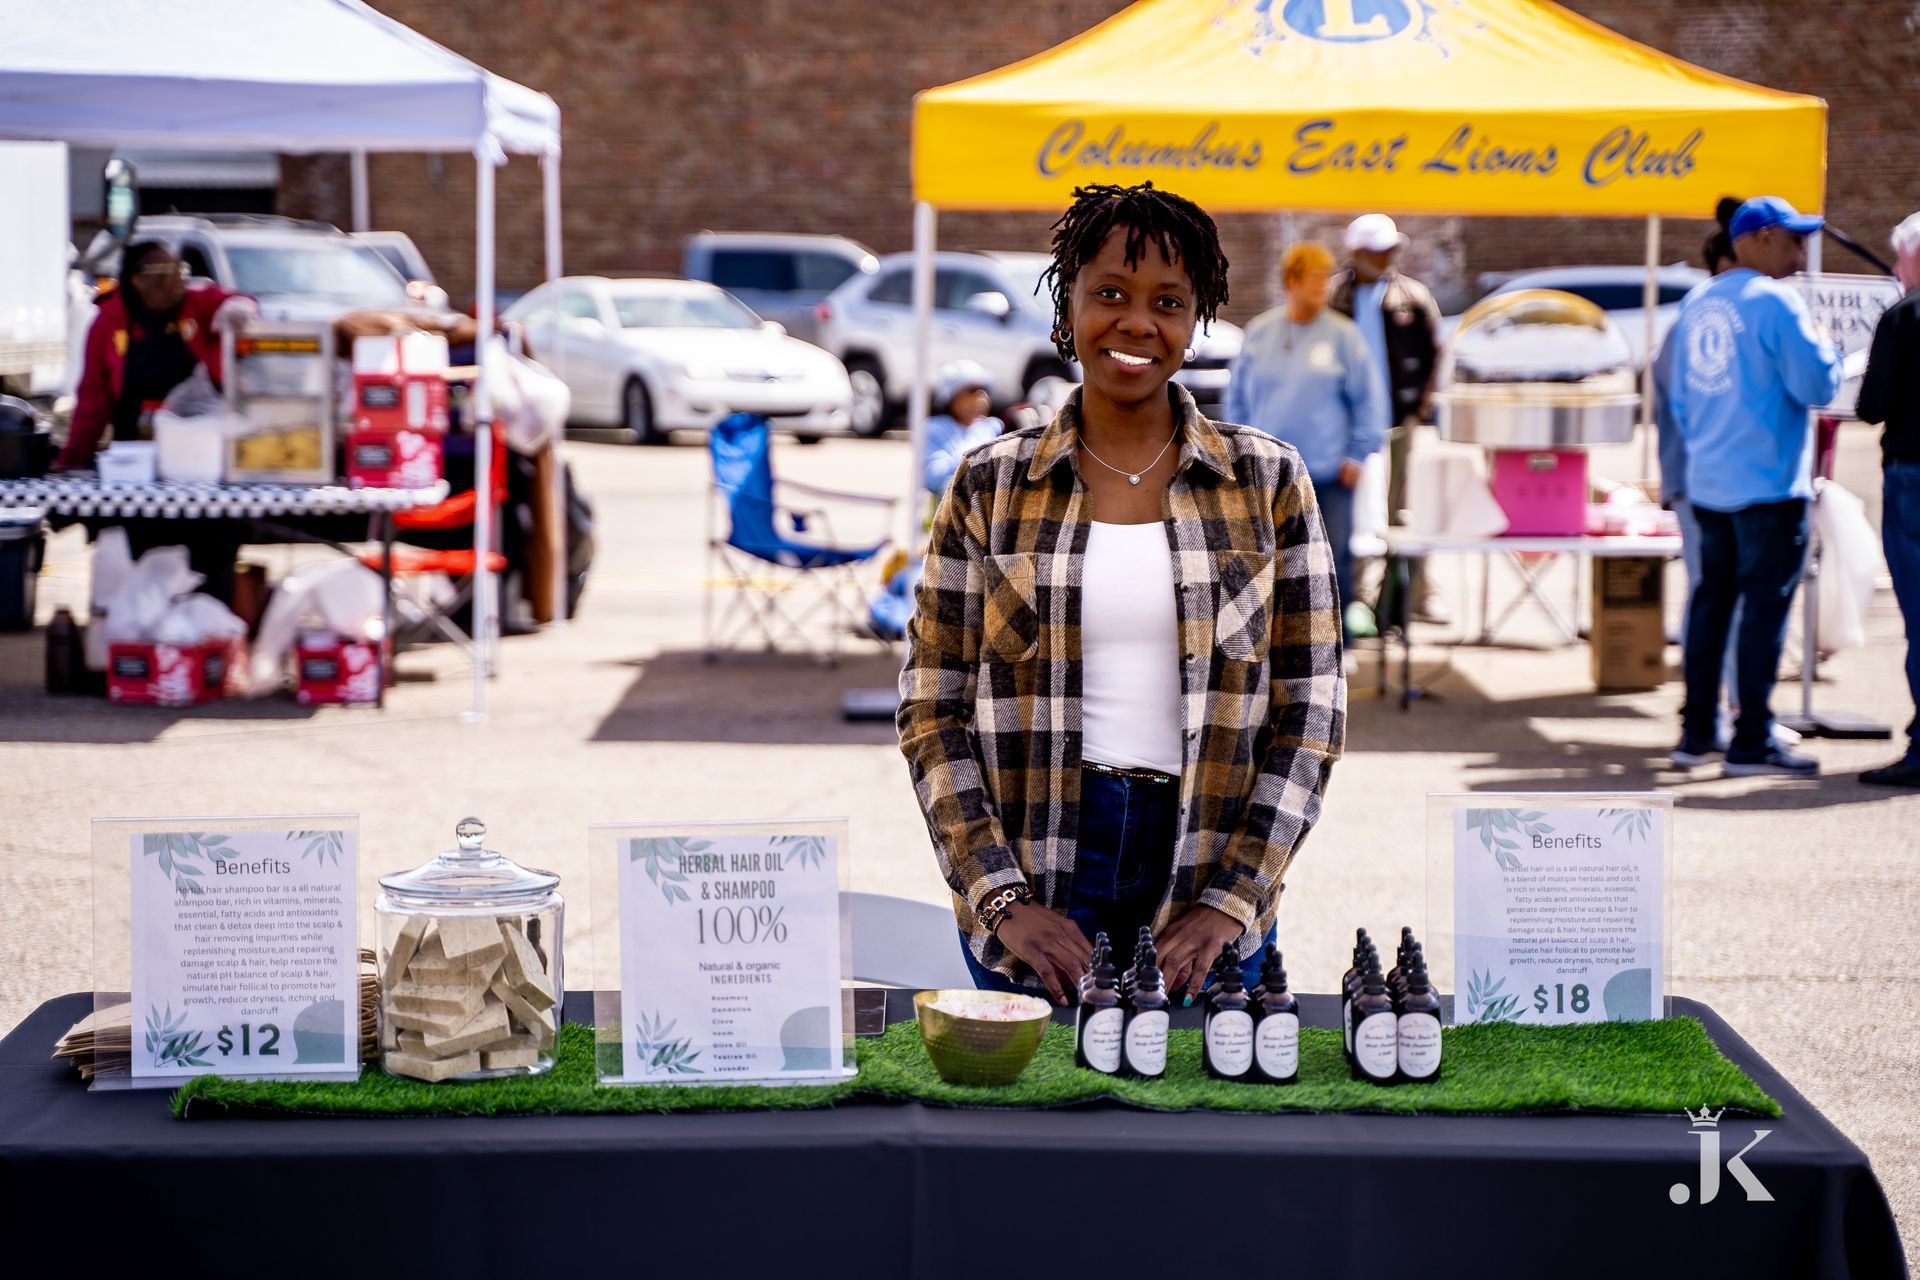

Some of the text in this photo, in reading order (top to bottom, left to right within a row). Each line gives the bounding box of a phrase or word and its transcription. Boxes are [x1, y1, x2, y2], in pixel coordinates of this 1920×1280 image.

[1036, 117, 1704, 187] Columbus East Lions Club
[1532, 834, 1602, 849] Benefits
[216, 859, 291, 875] Benefits
[679, 853, 784, 873] HERBAL HAIR OIL
[1548, 875, 1576, 884] multiple
[206, 885, 222, 893] hair
[225, 885, 264, 895] shampoo
[267, 884, 280, 892] bar
[282, 884, 289, 892] is
[298, 884, 308, 892] all
[311, 884, 341, 892] natural
[701, 880, 775, 899] & SHAMPOO
[1604, 885, 1637, 893] essential,
[174, 898, 214, 908] shampoo
[216, 898, 232, 907] bar,
[253, 897, 261, 905] in
[263, 897, 302, 906] vitamins,
[304, 896, 342, 905] minerals,
[1515, 896, 1532, 904] fatty
[178, 908, 338, 920] essential, fatty acids and antioxidants
[1506, 906, 1537, 914] generate
[1539, 906, 1557, 914] deep
[1588, 906, 1606, 914] scalp
[194, 922, 217, 930] clean
[219, 922, 225, 930] &
[227, 922, 251, 930] detox
[254, 921, 275, 931] deep
[277, 921, 294, 929] into
[312, 920, 334, 930] scalp
[336, 920, 342, 928] &
[697, 905, 788, 944] 100%
[1510, 916, 1553, 925] replenishing
[1603, 916, 1634, 925] repairing
[1507, 926, 1535, 935] damage
[1537, 926, 1555, 935] scalp
[1580, 926, 1596, 935] help
[213, 934, 254, 944] removing
[256, 934, 298, 943] impurities
[300, 933, 323, 941] while
[1589, 936, 1608, 945] scalp
[184, 947, 236, 957] replenishing
[296, 945, 335, 955] repairing
[1590, 946, 1620, 955] promote
[180, 959, 214, 969] damage
[216, 958, 239, 968] scalp
[241, 958, 247, 966] &
[270, 958, 288, 968] help
[290, 957, 321, 965] restore
[323, 957, 338, 965] the
[700, 960, 781, 972] Natural & organic
[1510, 957, 1536, 966] growth,
[1564, 957, 1593, 965] dryness,
[1595, 956, 1620, 965] itching
[186, 971, 217, 979] natural
[220, 971, 232, 981] pH
[234, 970, 267, 978] balance
[269, 970, 279, 978] of
[280, 970, 303, 980] scalp
[710, 974, 772, 984] INGREDIENTS
[182, 984, 219, 992] simulate
[221, 983, 237, 991] hair
[270, 982, 279, 990] to
[281, 982, 318, 992] promote
[320, 981, 336, 989] hair
[184, 996, 217, 1006] growth,
[218, 995, 248, 1003] reduce
[250, 995, 286, 1004] dryness,
[288, 994, 317, 1004] itching
[1533, 984, 1590, 1014] $18
[217, 1023, 280, 1056] $12
